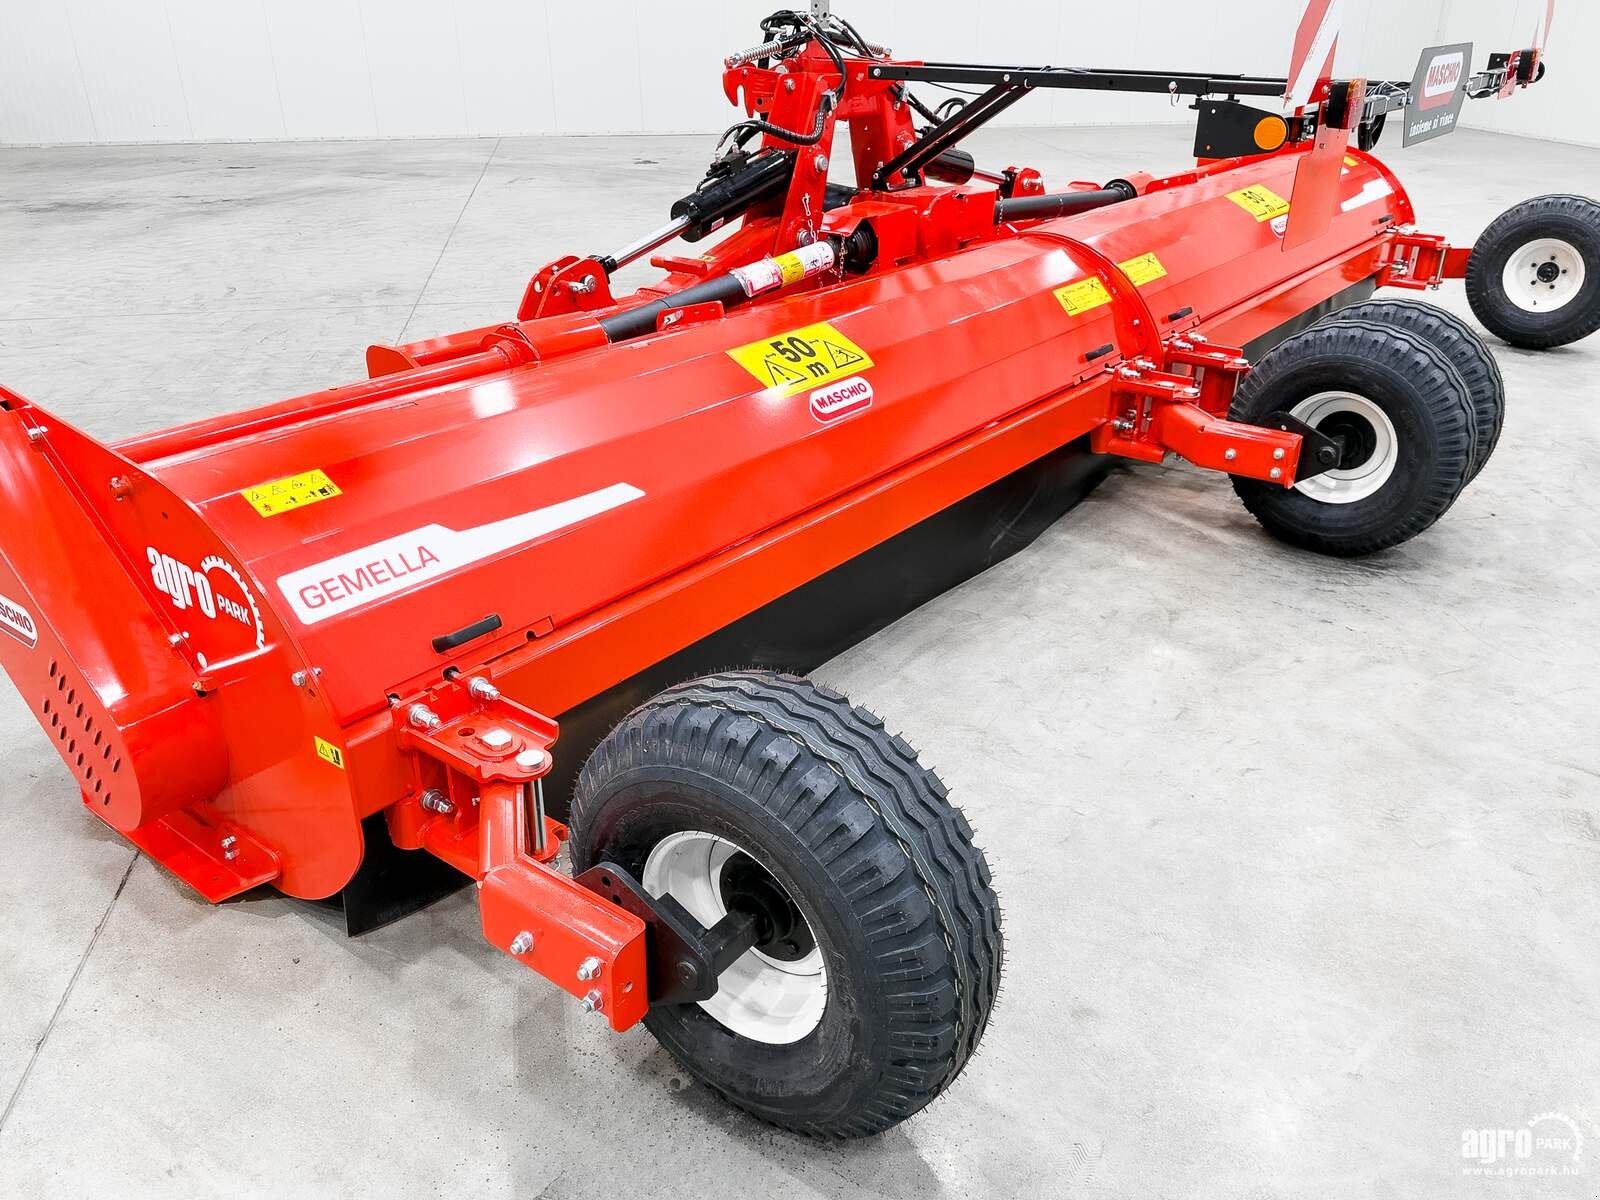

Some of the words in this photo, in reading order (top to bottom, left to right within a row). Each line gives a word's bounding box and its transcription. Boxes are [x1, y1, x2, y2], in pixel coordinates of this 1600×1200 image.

[1427, 61, 1460, 88] MASCHIO
[770, 336, 816, 363] 50
[806, 361, 830, 378] m
[815, 382, 868, 409] MASCHIO
[146, 546, 217, 619] agro
[216, 592, 251, 626] PARK
[299, 545, 440, 609] GEMELLA
